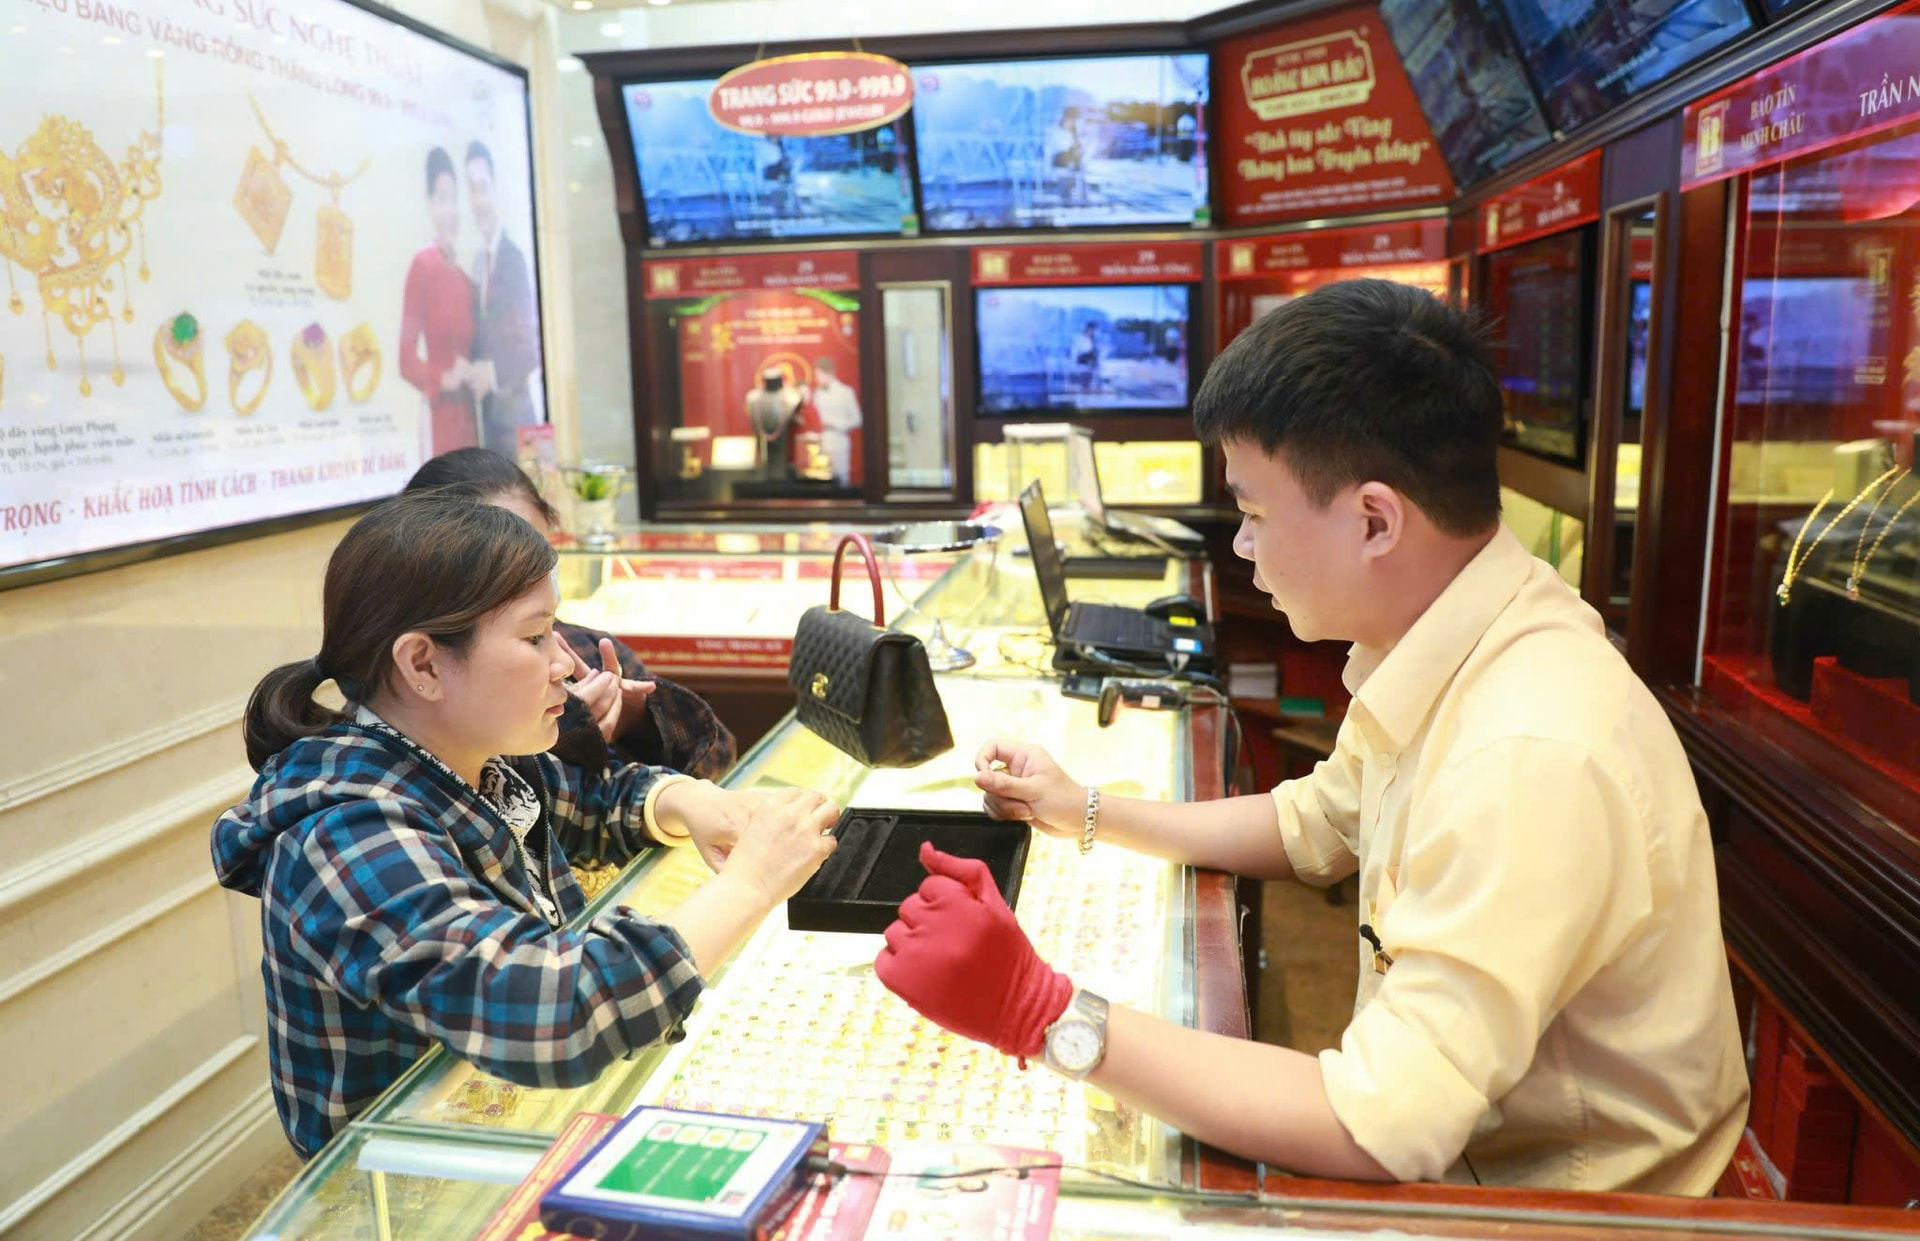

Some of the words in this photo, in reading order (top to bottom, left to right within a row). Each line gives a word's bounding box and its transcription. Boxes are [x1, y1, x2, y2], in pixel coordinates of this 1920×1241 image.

[718, 82, 777, 111] TRANG
[1858, 72, 1903, 118] TRẦN
[1741, 127, 1769, 152] MINH
[1770, 111, 1806, 143] CHÂU
